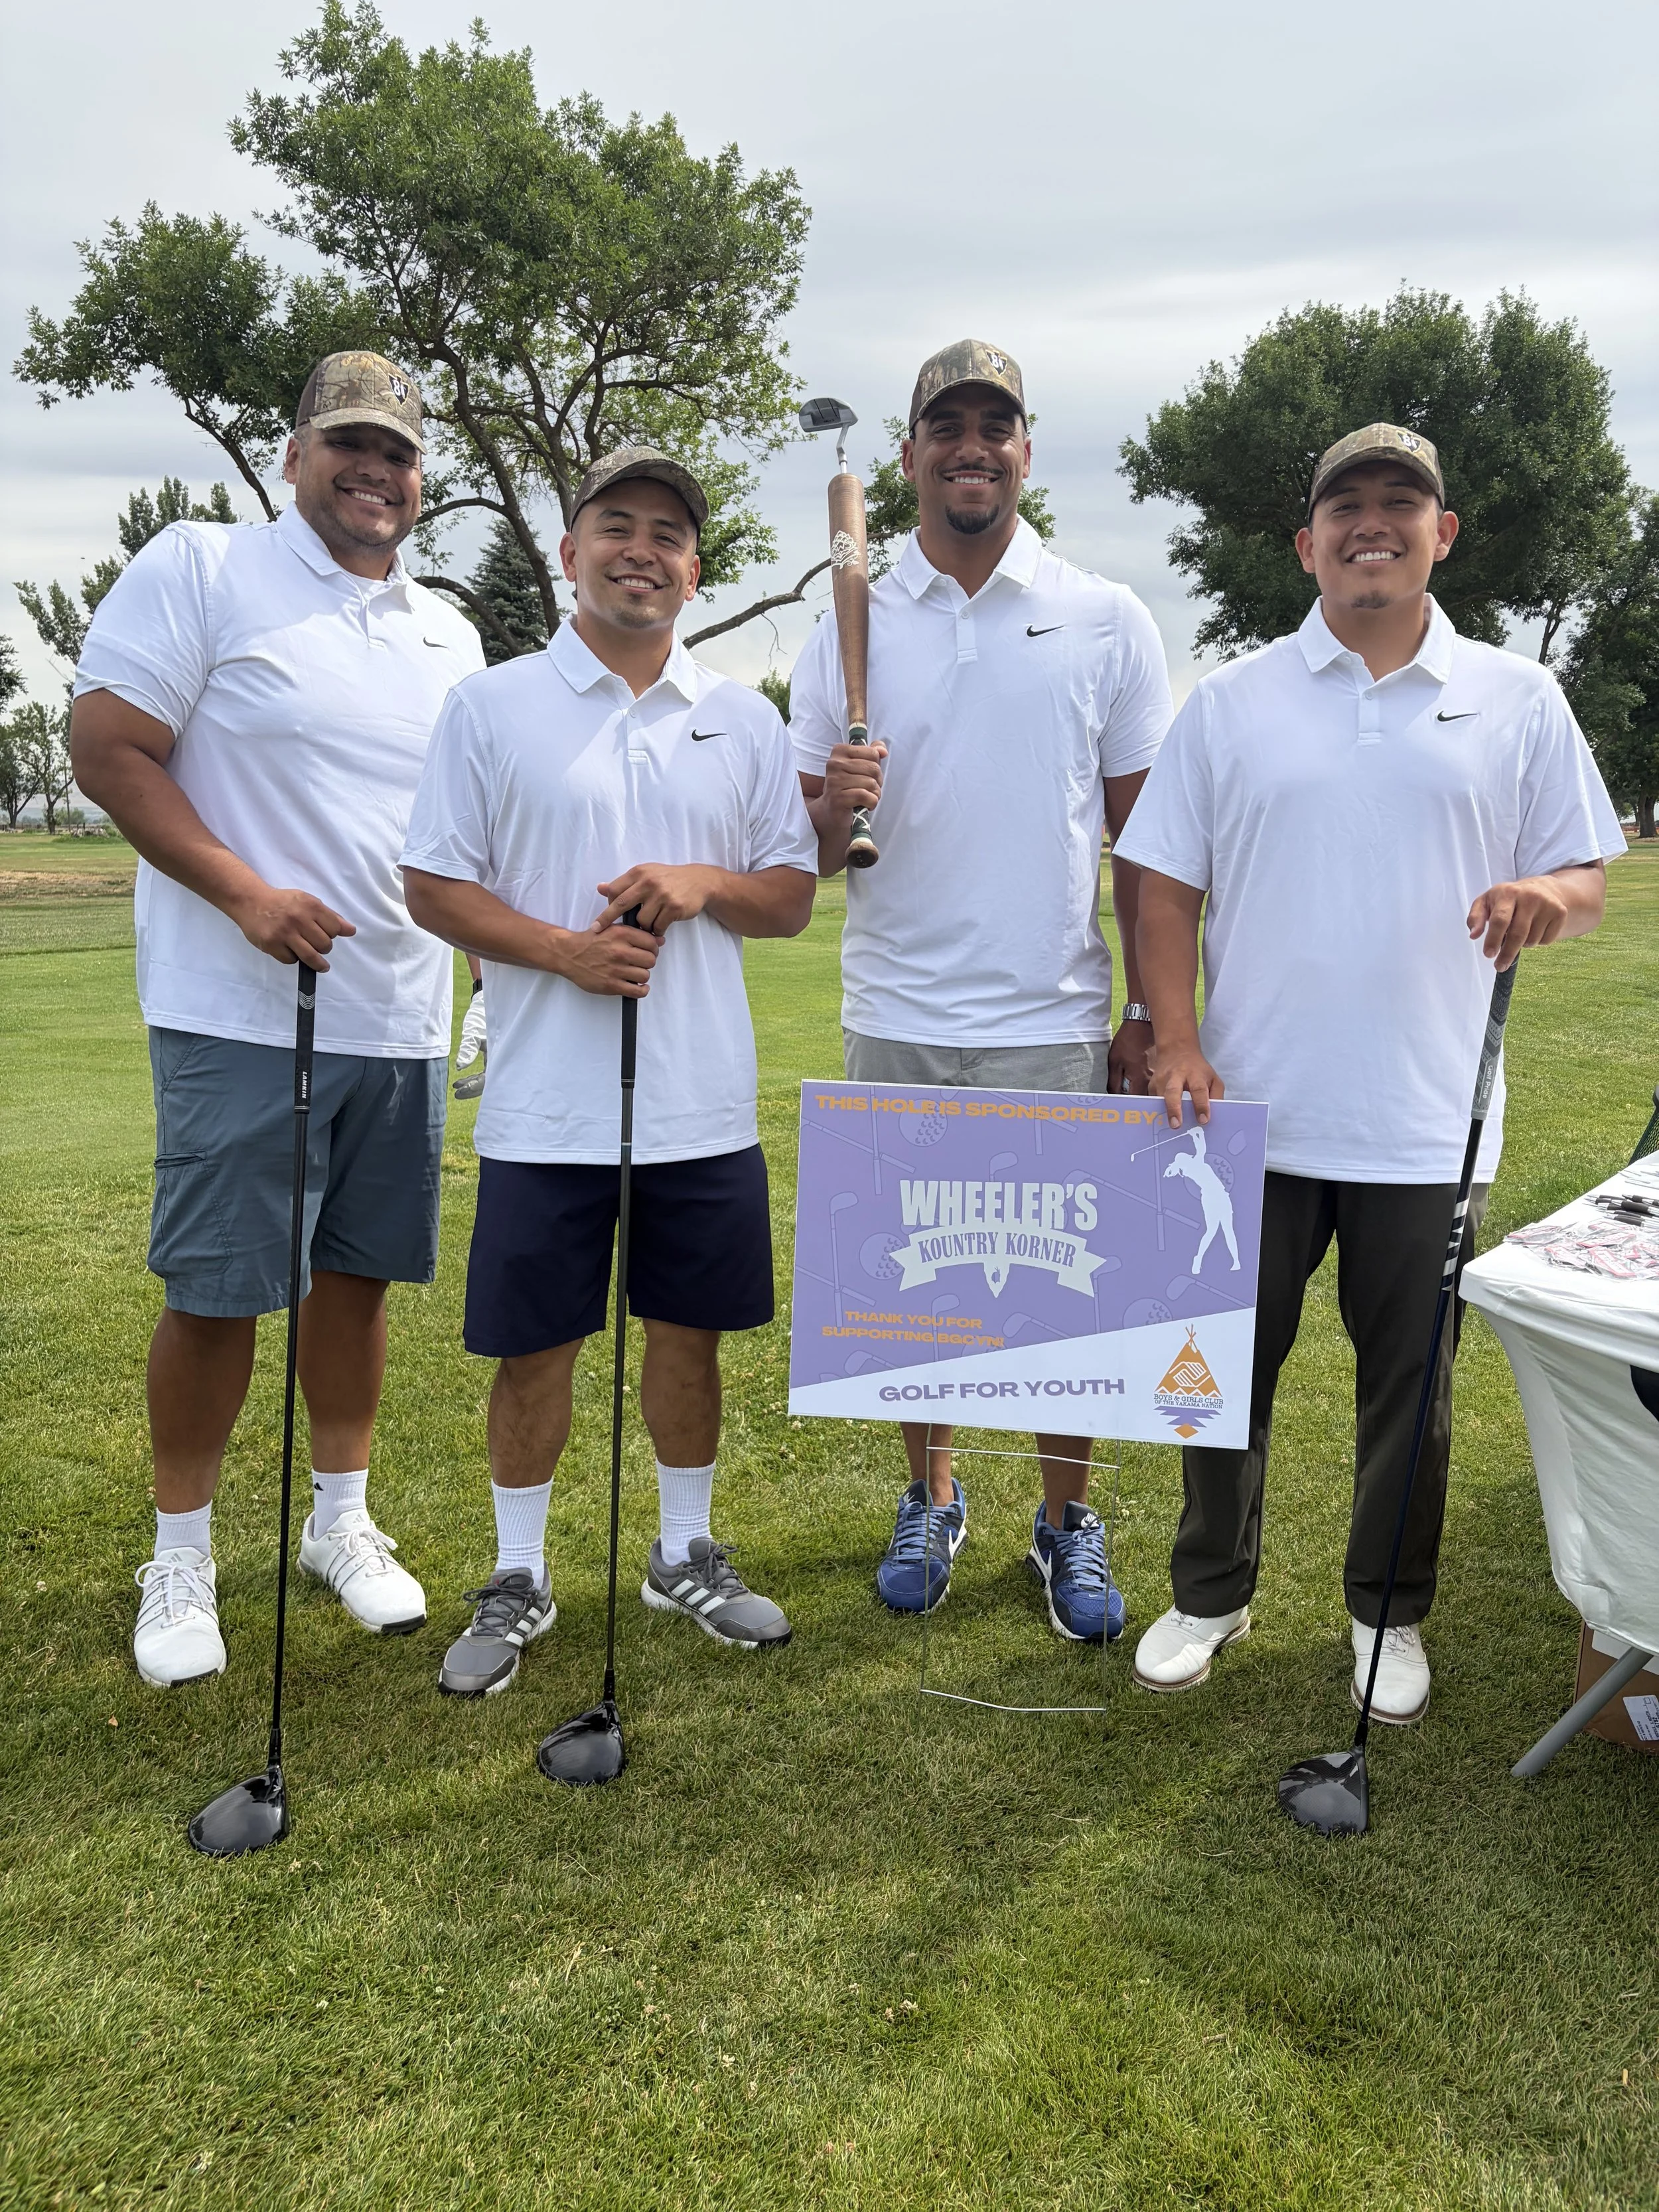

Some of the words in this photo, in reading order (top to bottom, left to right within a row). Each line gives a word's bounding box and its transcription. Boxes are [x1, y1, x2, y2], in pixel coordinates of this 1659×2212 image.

[1482, 1080, 1492, 1099] Pride
[815, 1095, 869, 1111] THIS
[872, 1098, 935, 1114] HOLE
[938, 1101, 962, 1116] IS
[966, 1102, 1120, 1123] SPONSORED
[1123, 1110, 1163, 1126] BY:
[900, 1180, 1098, 1231] WHEELER'S
[918, 1232, 998, 1263] KOUNTRY
[1005, 1232, 1076, 1268] KORNER
[845, 1311, 903, 1324] THANK
[906, 1314, 944, 1327] YOU
[946, 1317, 983, 1329] FOR
[822, 1327, 934, 1343] SUPPORTING
[879, 1383, 956, 1402] GOLF
[959, 1381, 1020, 1398] FOR
[1023, 1378, 1125, 1396] YOUTH
